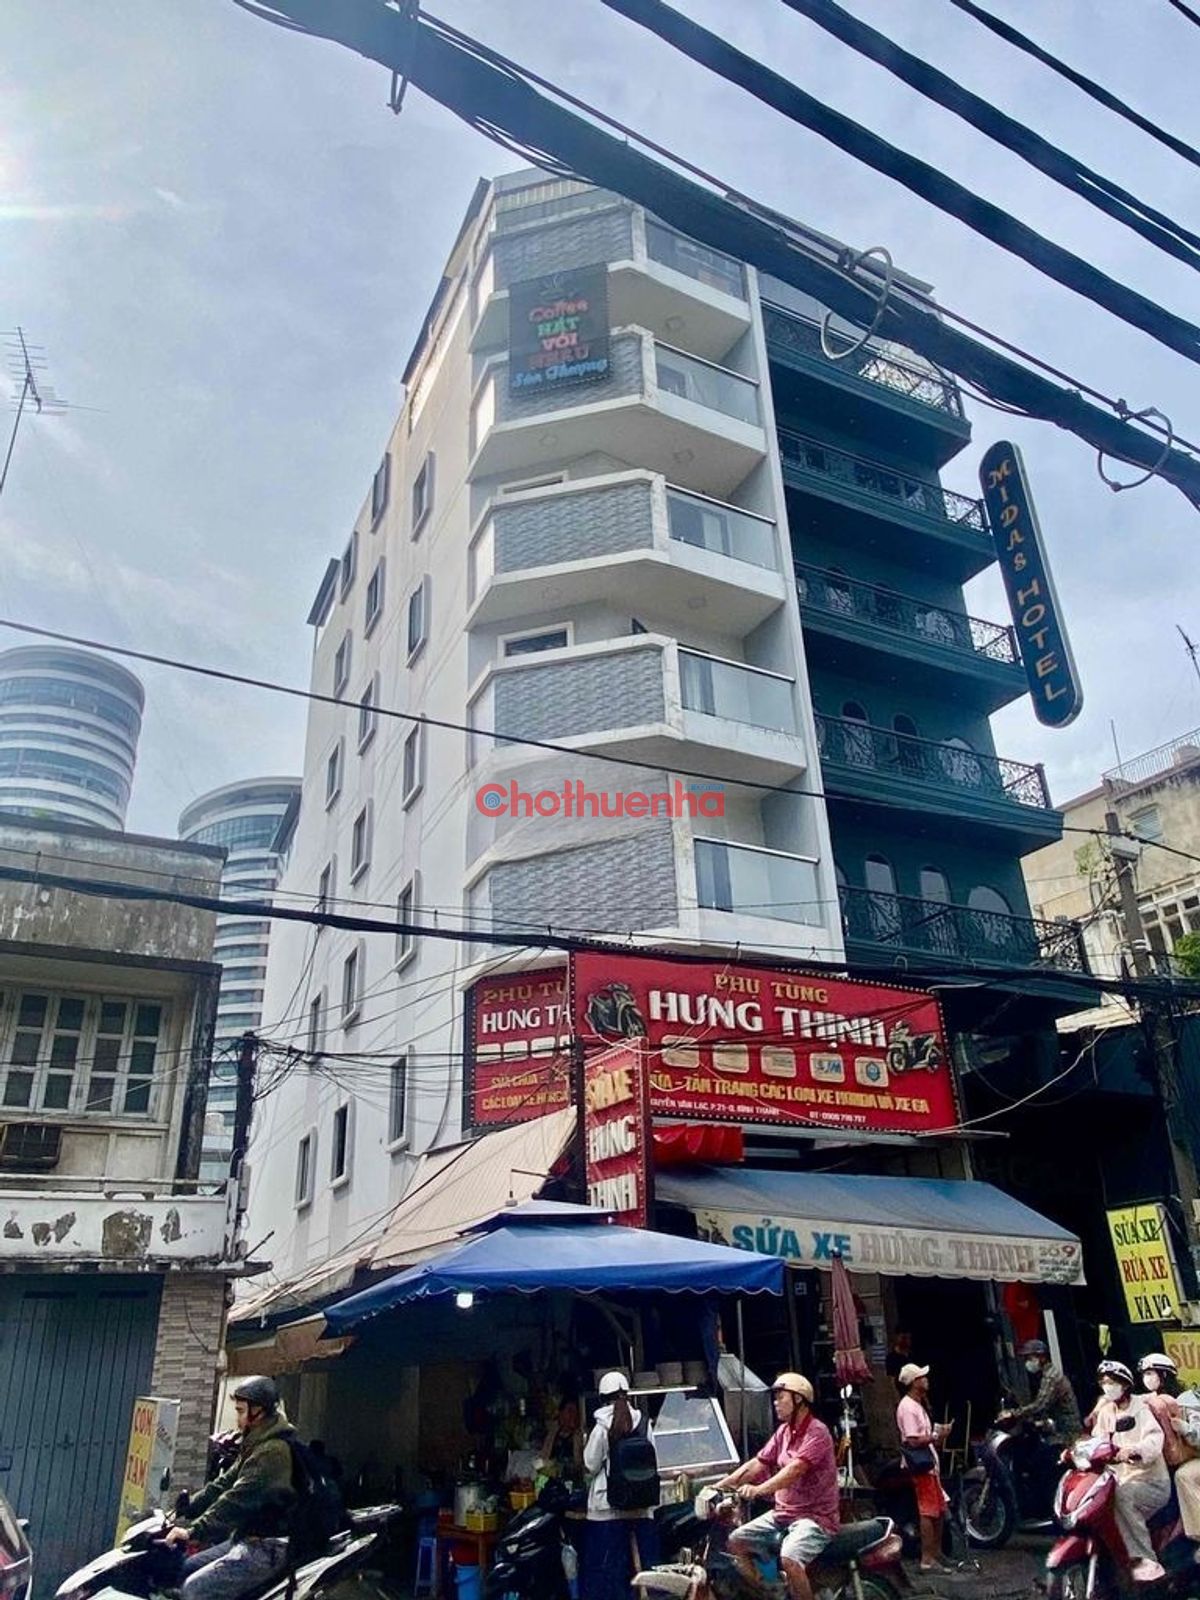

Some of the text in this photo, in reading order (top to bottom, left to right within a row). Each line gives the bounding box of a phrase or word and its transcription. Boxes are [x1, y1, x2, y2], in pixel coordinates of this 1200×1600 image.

[987, 459, 1067, 702] MIDAS HOTEL
[538, 978, 567, 997] TÙ
[714, 972, 829, 1004] PHỤ TÙNG
[482, 1006, 541, 1034] HƯNG
[649, 990, 888, 1048] HƯNG THỊNH
[712, 1077, 758, 1097] TRANG
[817, 1088, 835, 1104] XE
[894, 1096, 911, 1112] XE
[912, 1098, 930, 1114] GA
[589, 1114, 636, 1164] HƯNG
[731, 1217, 853, 1262] SỬA XE
[1114, 1214, 1161, 1247] SỬA XE
[857, 1230, 942, 1267] HƯNG
[1061, 1244, 1076, 1258] 9
[1121, 1250, 1169, 1283] RỬA XE
[1134, 1287, 1154, 1321] VÁ
[1168, 1335, 1200, 1370] SỬ
